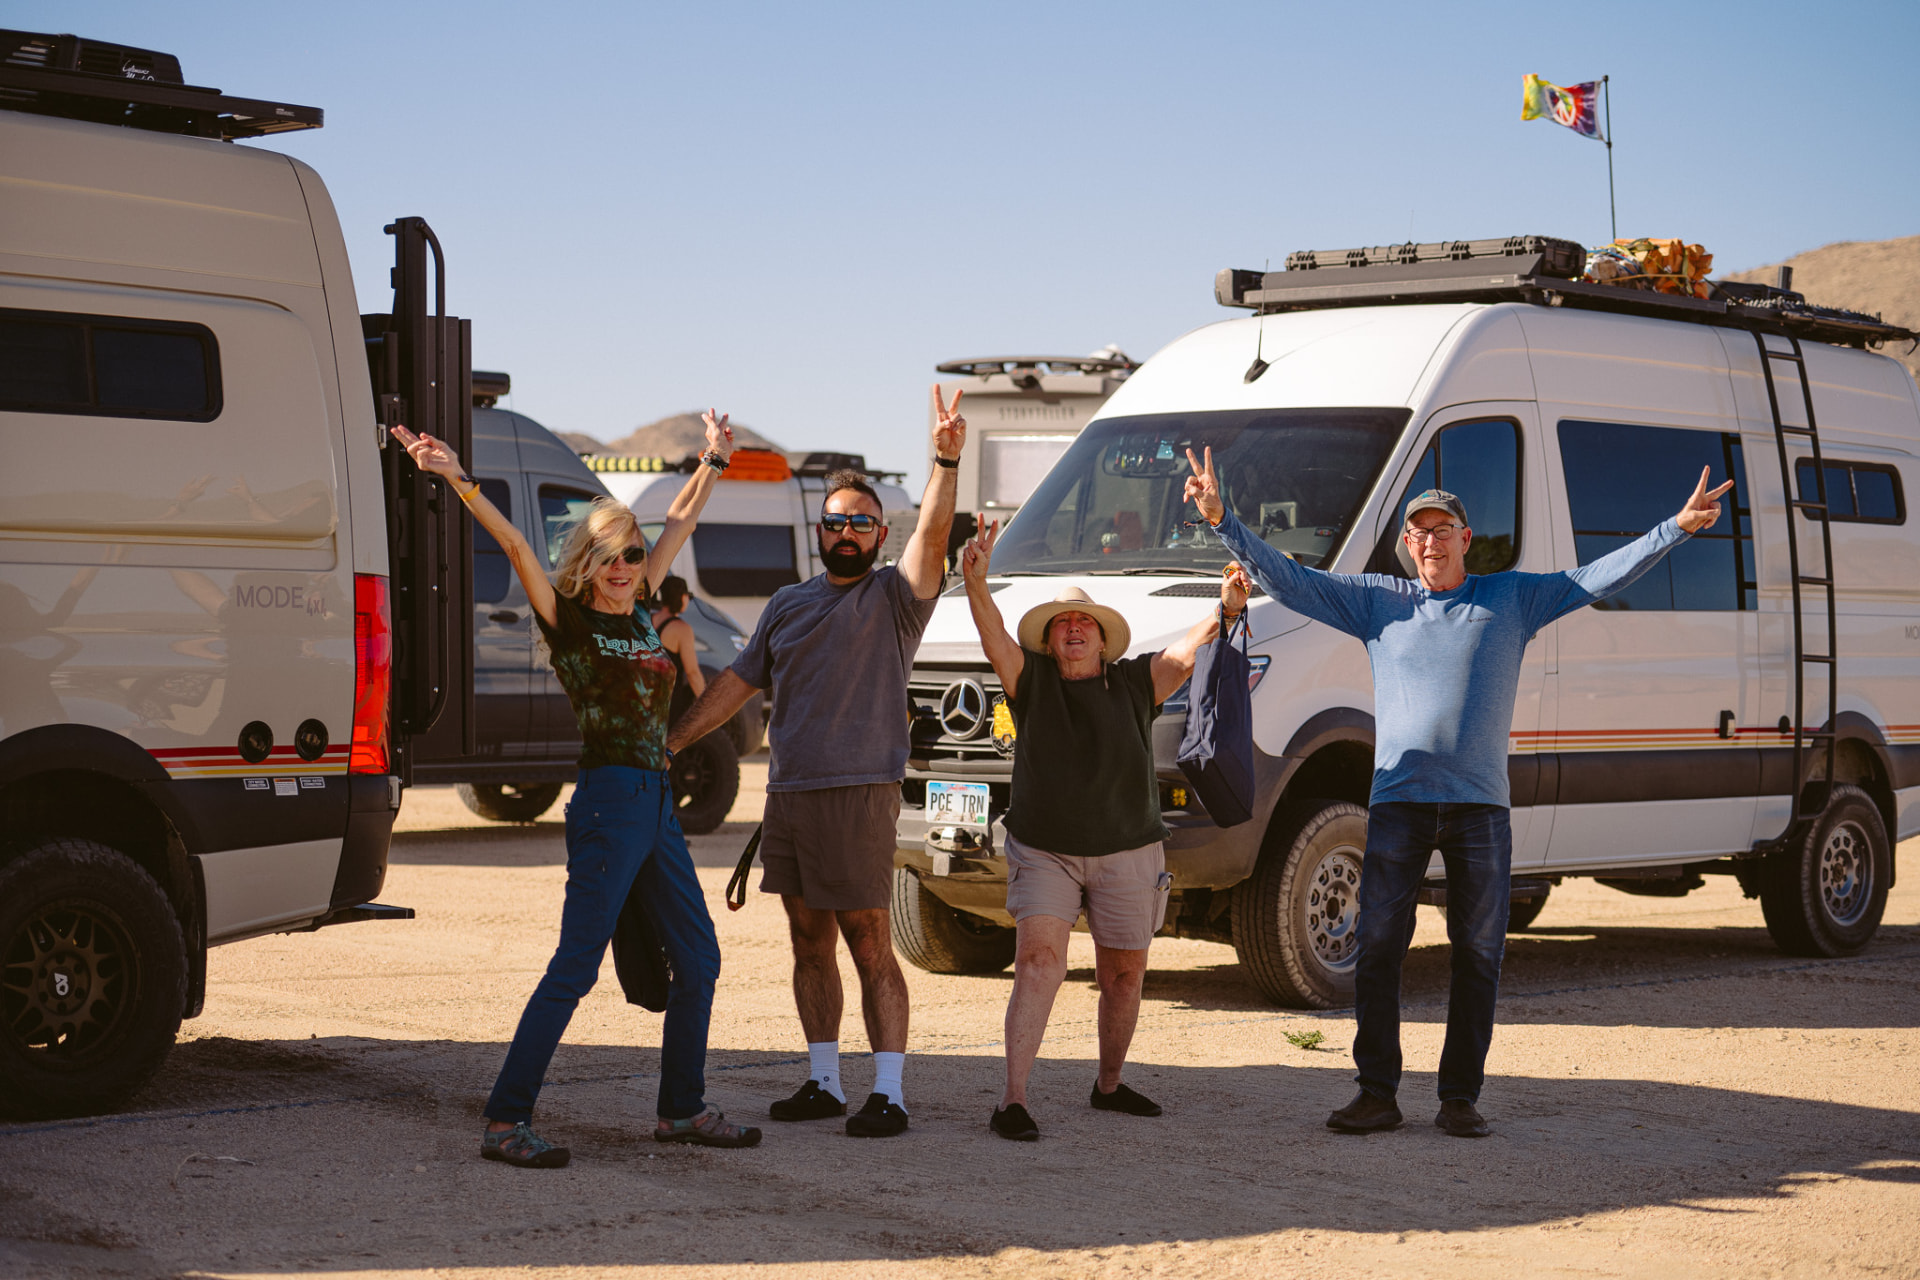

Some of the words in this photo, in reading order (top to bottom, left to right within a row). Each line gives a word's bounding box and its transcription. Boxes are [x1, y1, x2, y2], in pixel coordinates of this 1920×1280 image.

[236, 585, 304, 609] MODE
[1905, 624, 1920, 641] MO
[930, 792, 953, 812] PCE
[961, 794, 985, 814] TRN
